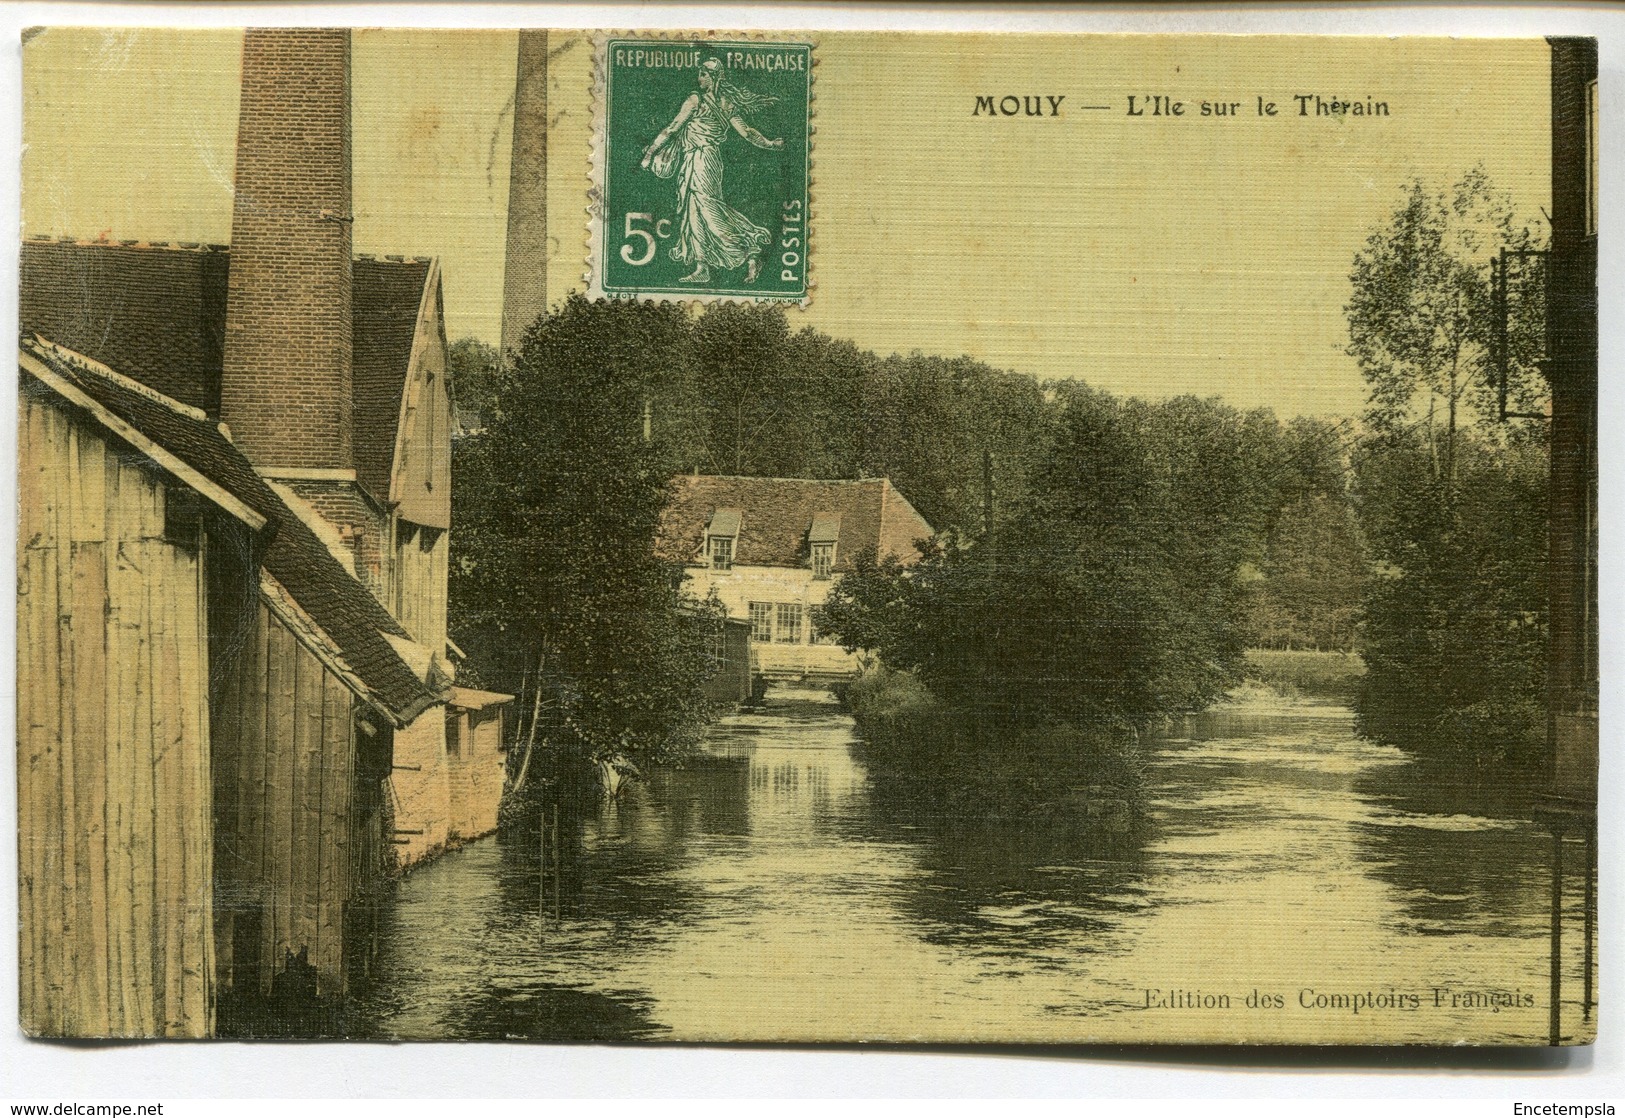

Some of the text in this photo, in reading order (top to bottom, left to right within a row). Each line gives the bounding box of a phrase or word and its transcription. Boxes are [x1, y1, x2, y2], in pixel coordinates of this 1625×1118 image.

[727, 52, 804, 71] FRANÇAISE
[972, 95, 1066, 117] MOUY
[1126, 95, 1185, 117] L'Ile
[1200, 100, 1241, 117] sur
[1257, 96, 1279, 117] le
[781, 199, 802, 282] POSTES
[1144, 987, 1535, 1015] Edition des Comptoirs Français
